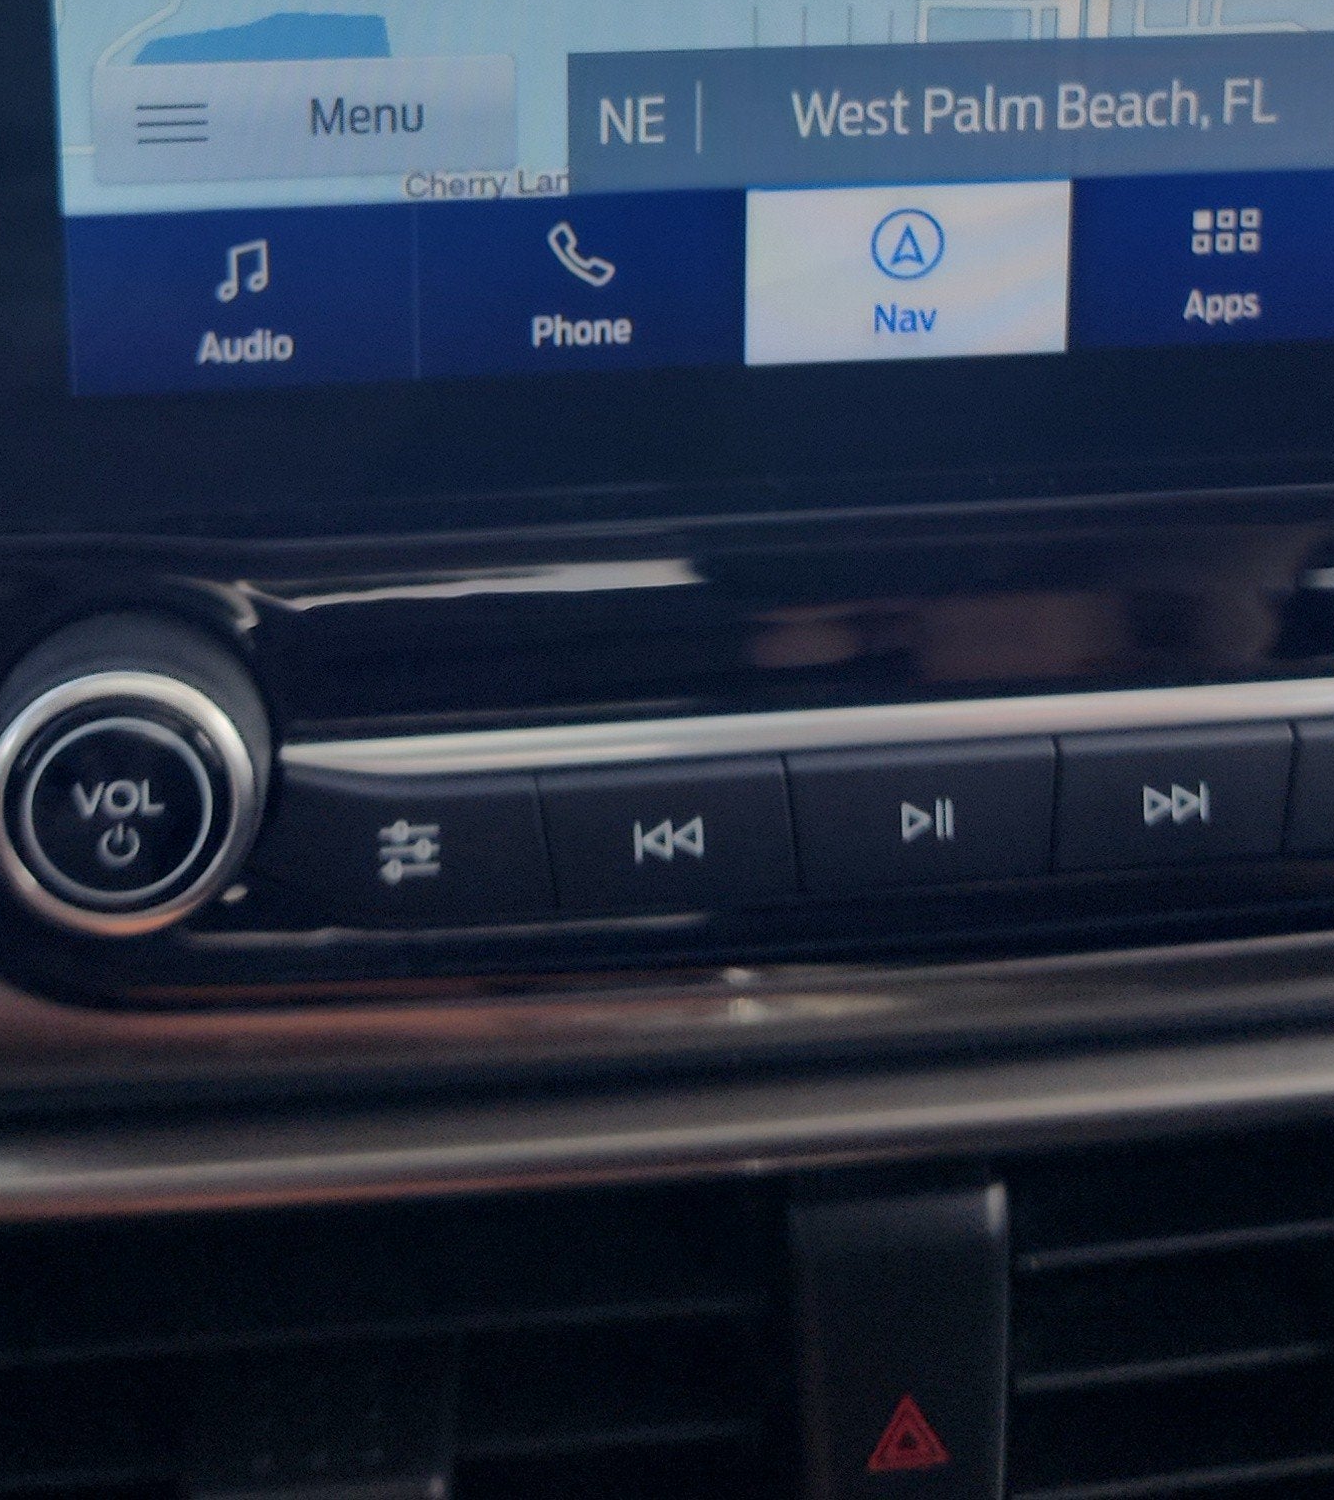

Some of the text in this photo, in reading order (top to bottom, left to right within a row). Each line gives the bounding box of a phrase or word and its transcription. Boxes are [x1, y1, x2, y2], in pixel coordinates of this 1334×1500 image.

[310, 98, 425, 136] Menu
[598, 95, 666, 146] NE
[791, 77, 1277, 139] West Palm Beach, FL
[405, 170, 507, 198] Cherry
[873, 303, 938, 334] Nav
[1183, 289, 1263, 324] Apps
[198, 329, 294, 365] Audio
[532, 314, 633, 347] Phone
[72, 779, 165, 819] VOL
